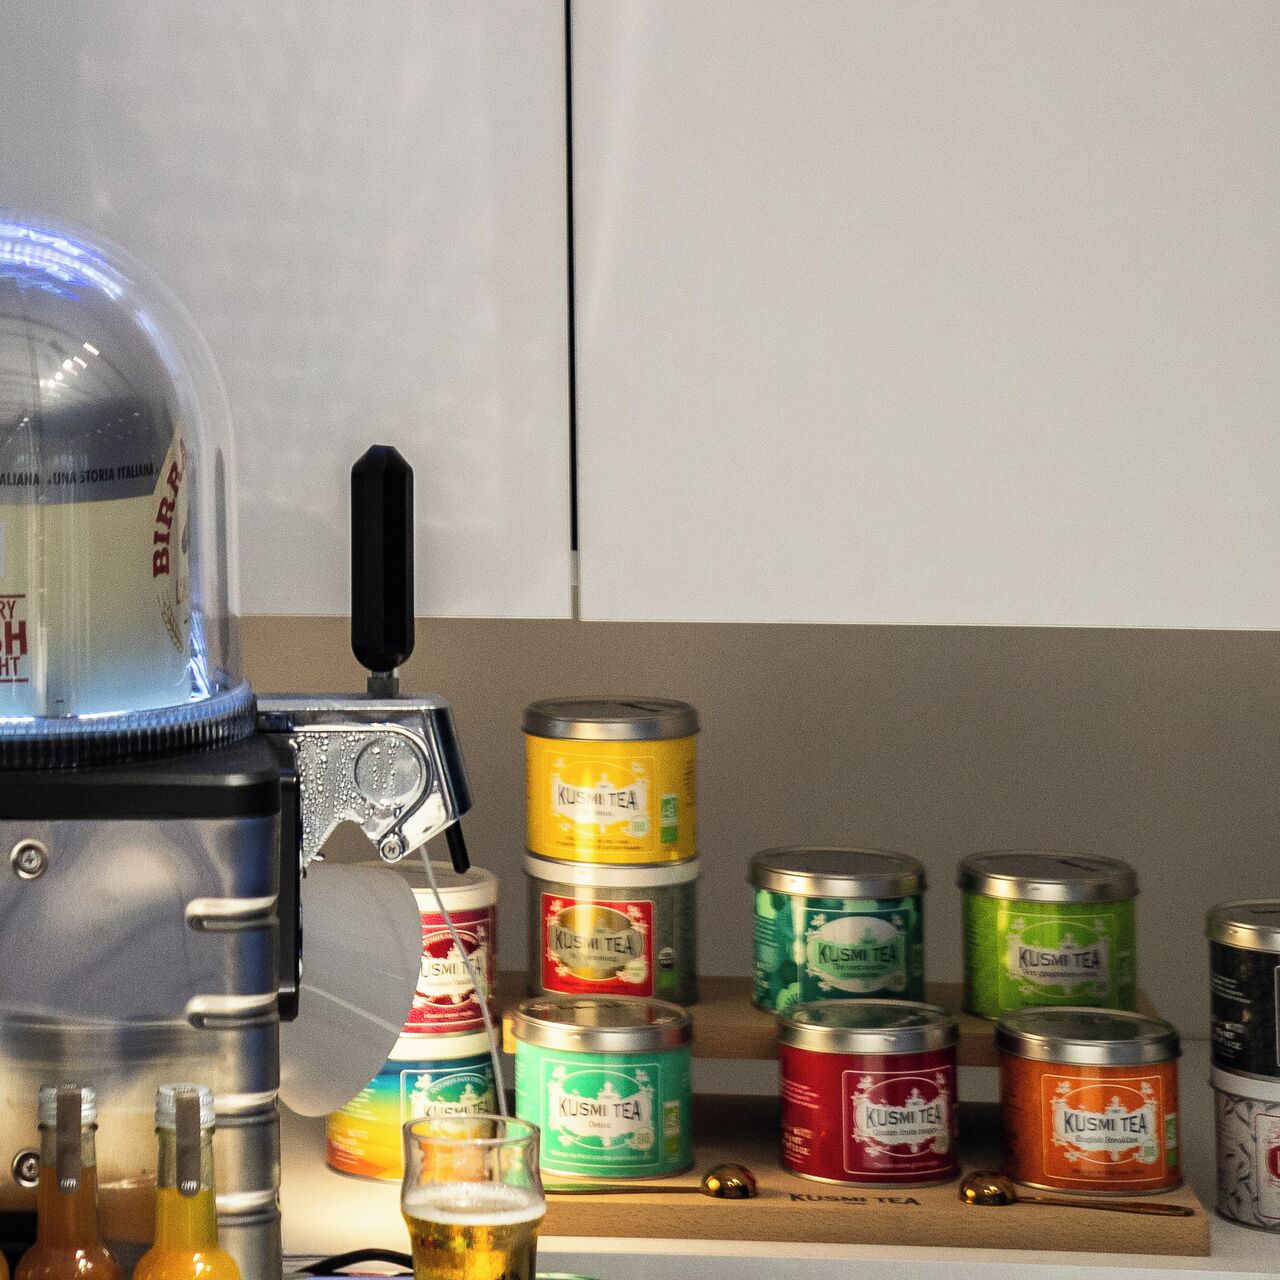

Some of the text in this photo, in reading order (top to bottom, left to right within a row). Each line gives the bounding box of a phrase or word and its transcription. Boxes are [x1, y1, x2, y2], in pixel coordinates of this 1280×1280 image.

[53, 471, 76, 485] UNA
[80, 468, 115, 484] STORIA
[118, 462, 154, 479] ITALIANA
[557, 784, 638, 811] KUSMI TEA
[555, 928, 635, 957] KUSMI TEA
[818, 942, 897, 964] KUSMI TEA
[421, 960, 456, 978] USMI
[1018, 947, 1100, 970] KUSMI TEA
[559, 1095, 642, 1122] KUSMI TEA
[866, 1104, 943, 1129] KUSMI TEA
[1064, 1111, 1148, 1135] KUSMI TEA
[1075, 1135, 1138, 1144] English Breakfast
[789, 1193, 922, 1206] KUSMI TEA
